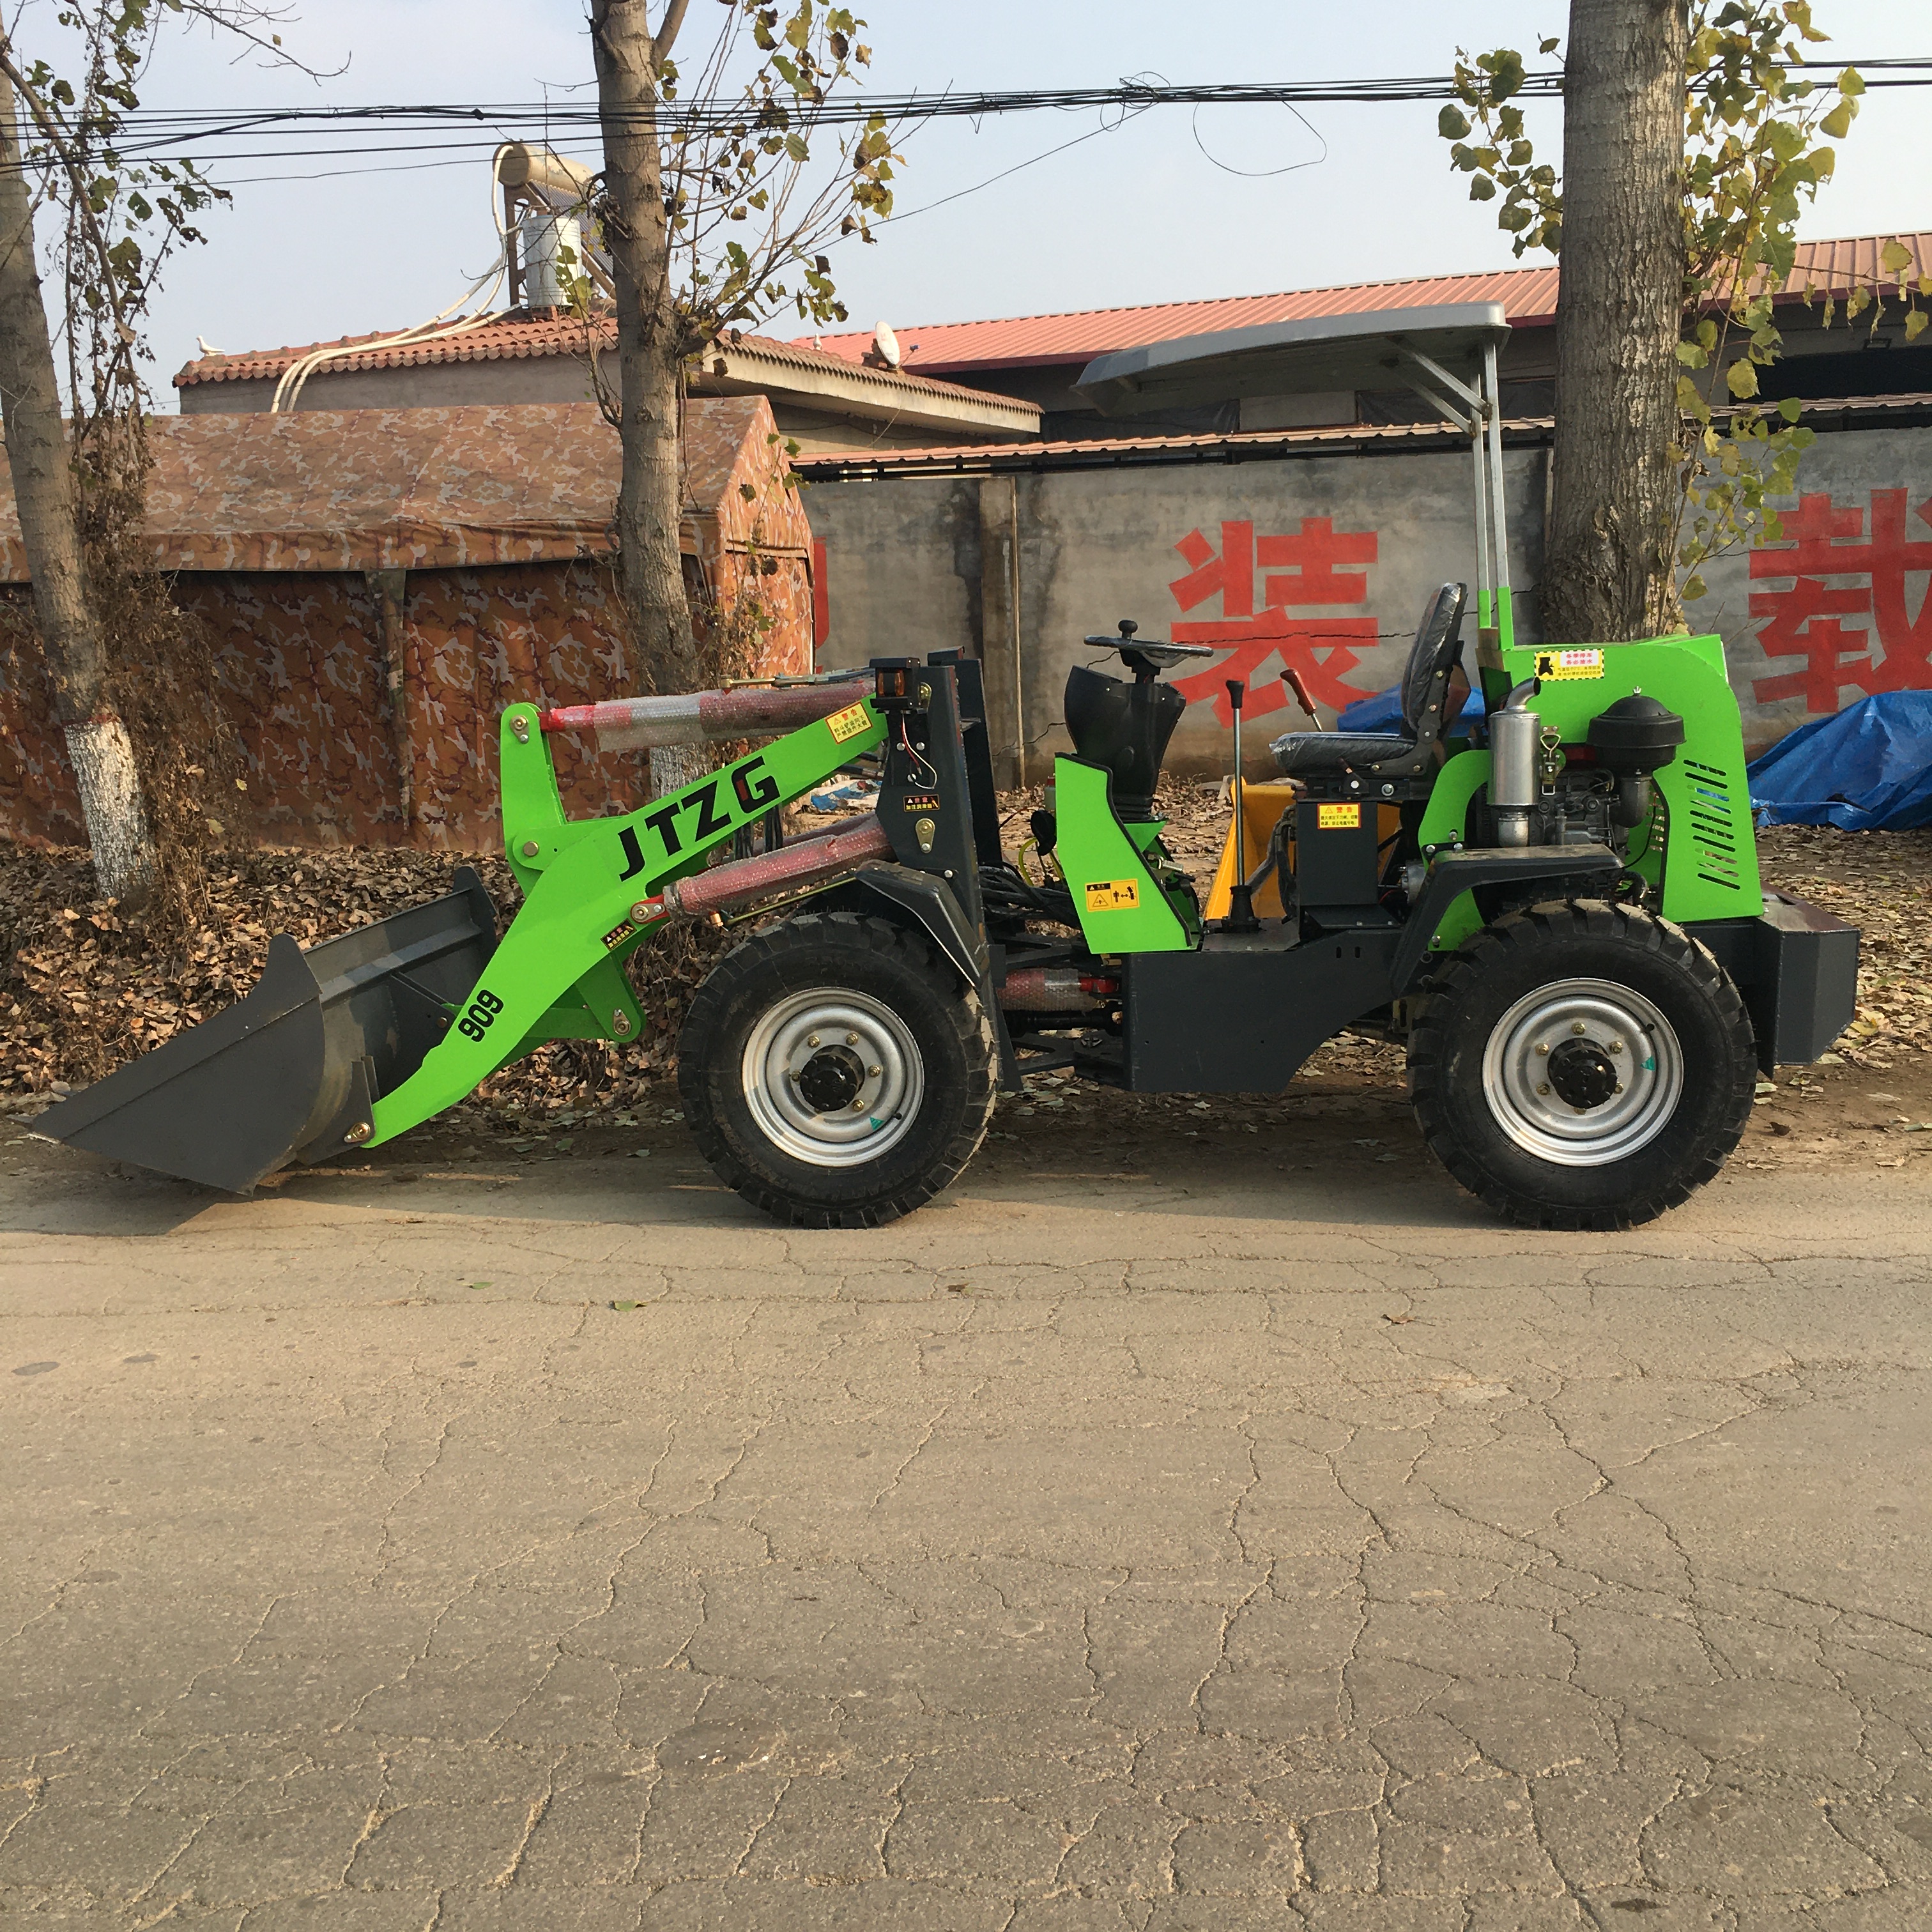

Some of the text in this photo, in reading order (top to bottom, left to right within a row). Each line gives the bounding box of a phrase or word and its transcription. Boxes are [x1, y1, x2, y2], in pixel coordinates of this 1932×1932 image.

[1168, 487, 1932, 730] 装 载
[617, 755, 781, 882] JTZG
[457, 989, 504, 1043] 909
